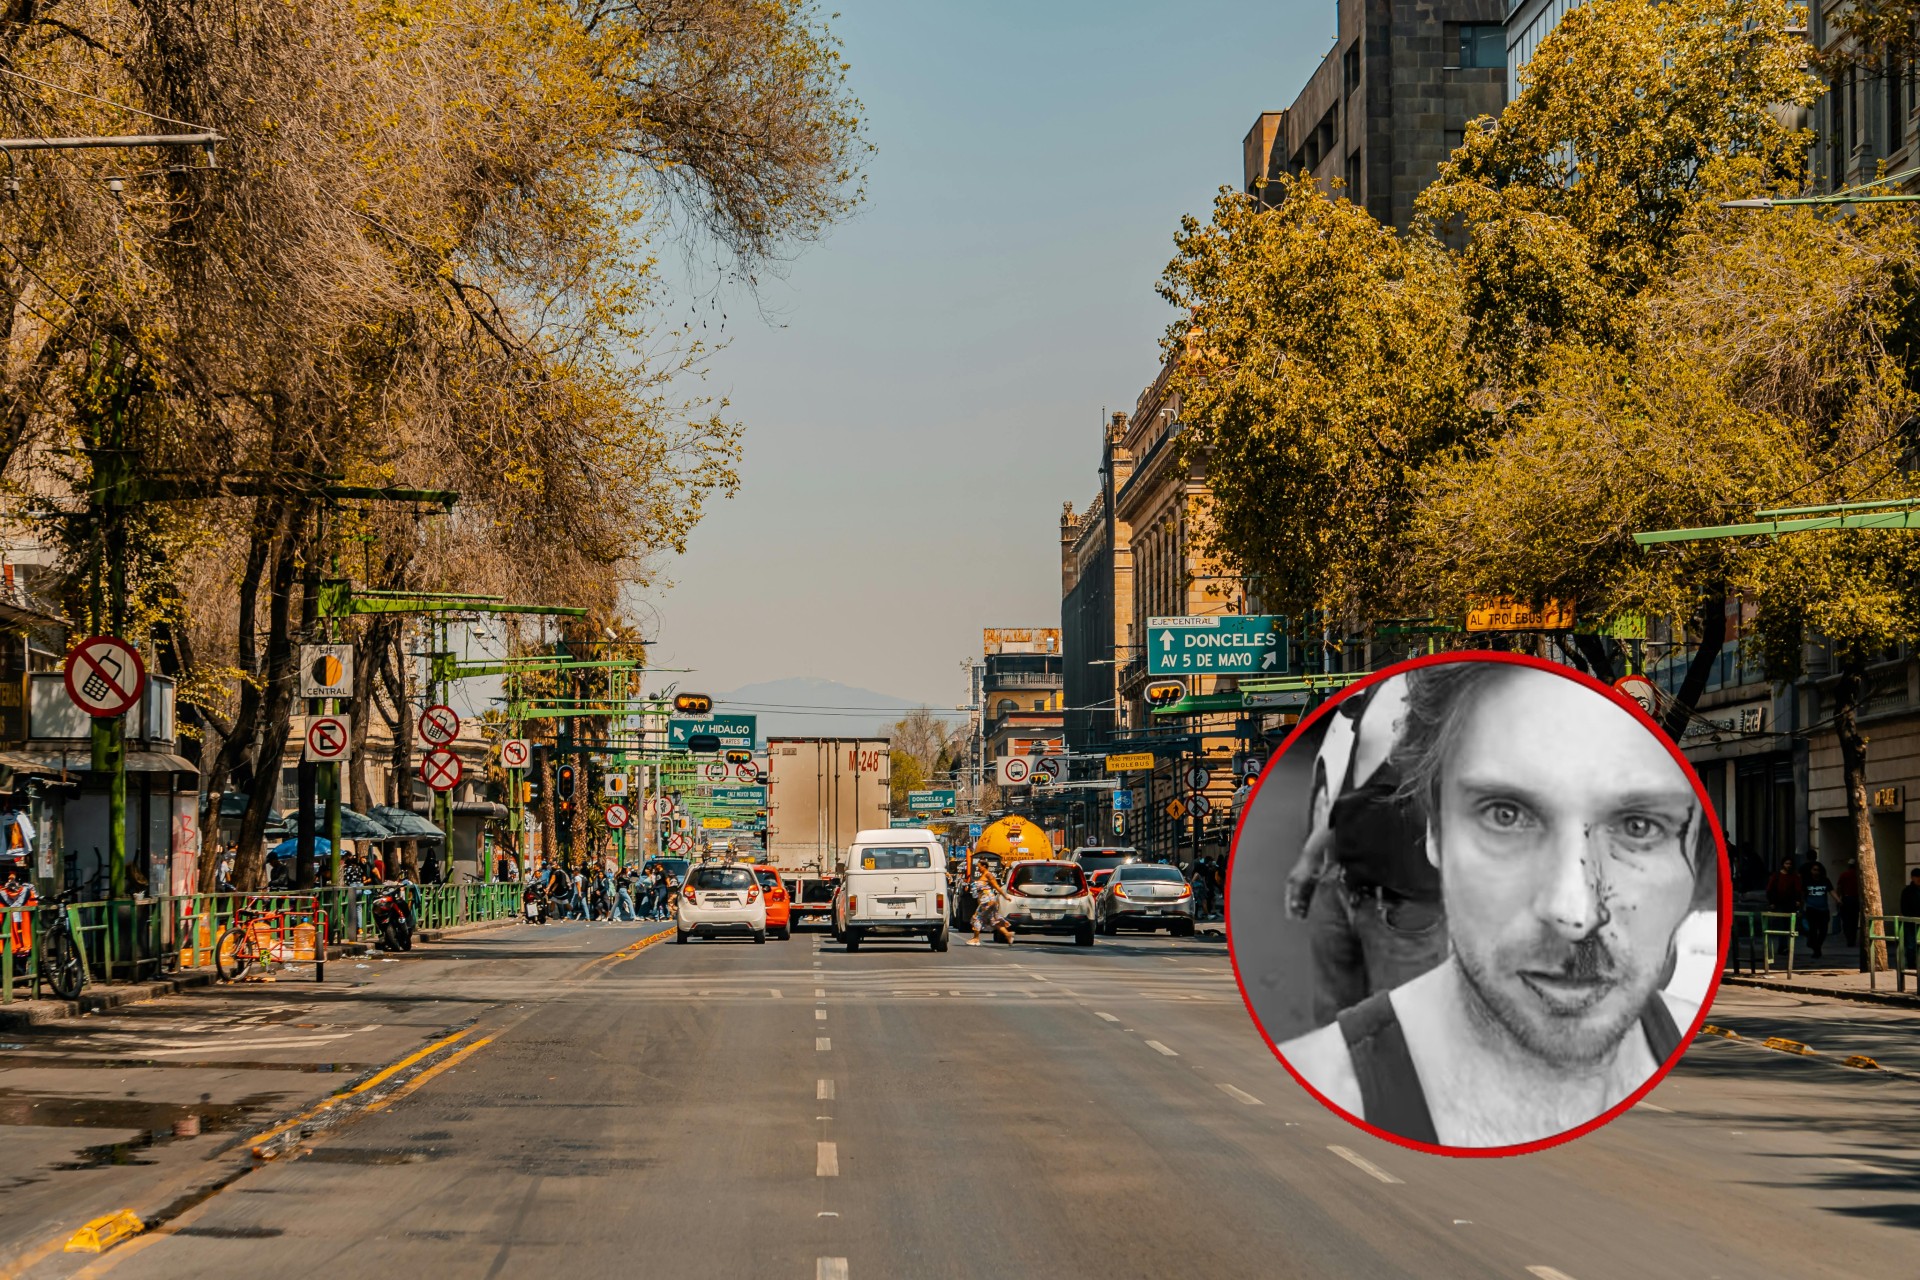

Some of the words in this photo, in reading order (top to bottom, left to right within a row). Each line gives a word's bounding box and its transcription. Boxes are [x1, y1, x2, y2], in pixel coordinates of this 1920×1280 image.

[1470, 614, 1483, 626] AL
[1488, 612, 1542, 625] TROLEBUS
[1184, 632, 1276, 648] DONCELES
[1161, 654, 1178, 668] AV
[1183, 654, 1191, 667] 5
[1196, 654, 1212, 666] DE
[1218, 652, 1252, 666] MAYO
[307, 688, 348, 696] CENTRAL
[692, 724, 705, 733] AV
[708, 725, 750, 734] HIDALGO
